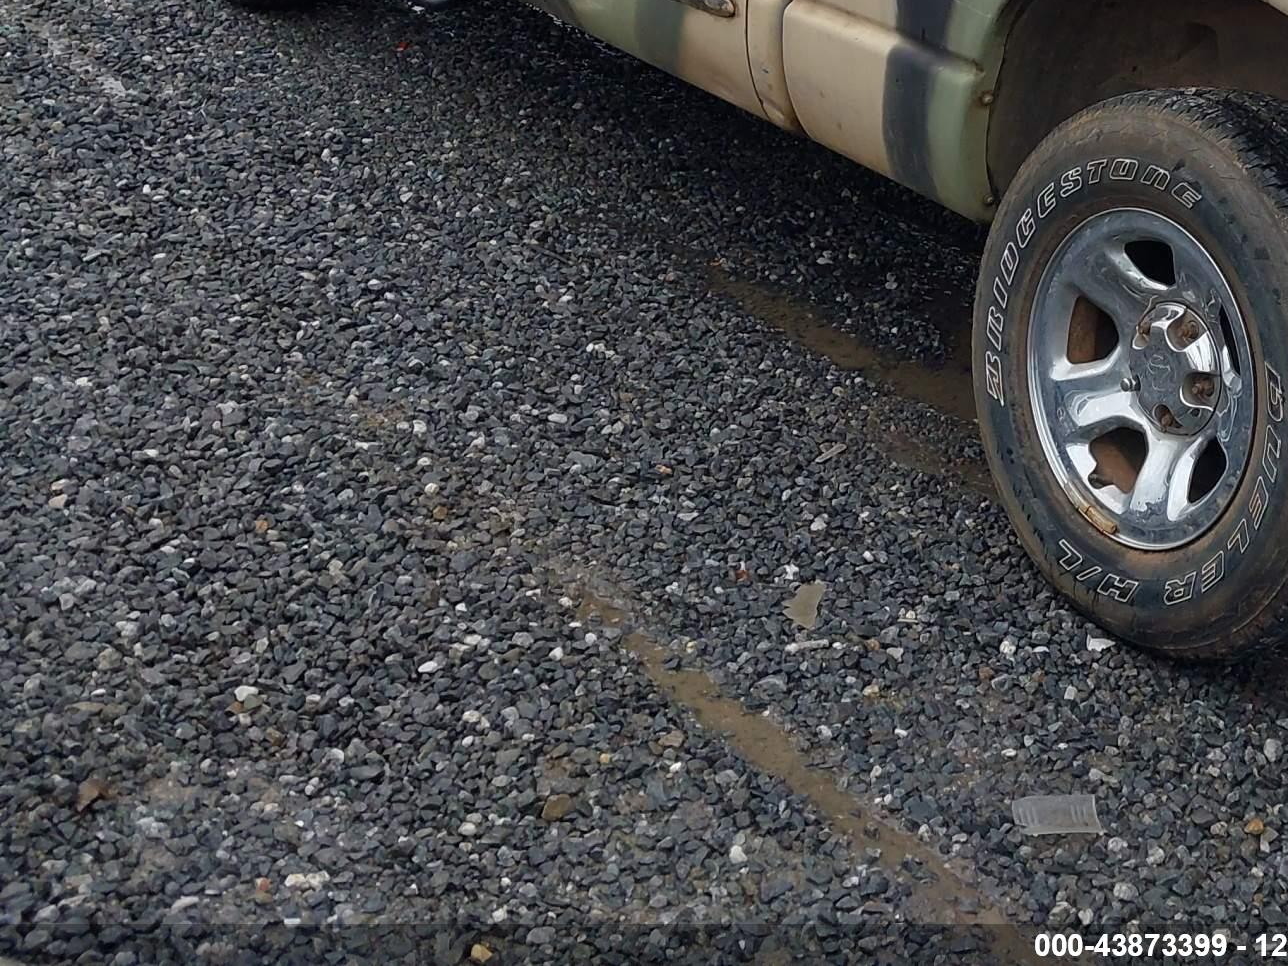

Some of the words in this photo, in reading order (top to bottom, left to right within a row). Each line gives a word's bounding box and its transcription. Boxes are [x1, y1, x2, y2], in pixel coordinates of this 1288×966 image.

[984, 157, 1203, 407] BRIDGESTONE
[1058, 538, 1139, 603] H/L
[1163, 361, 1284, 606] DUELER
